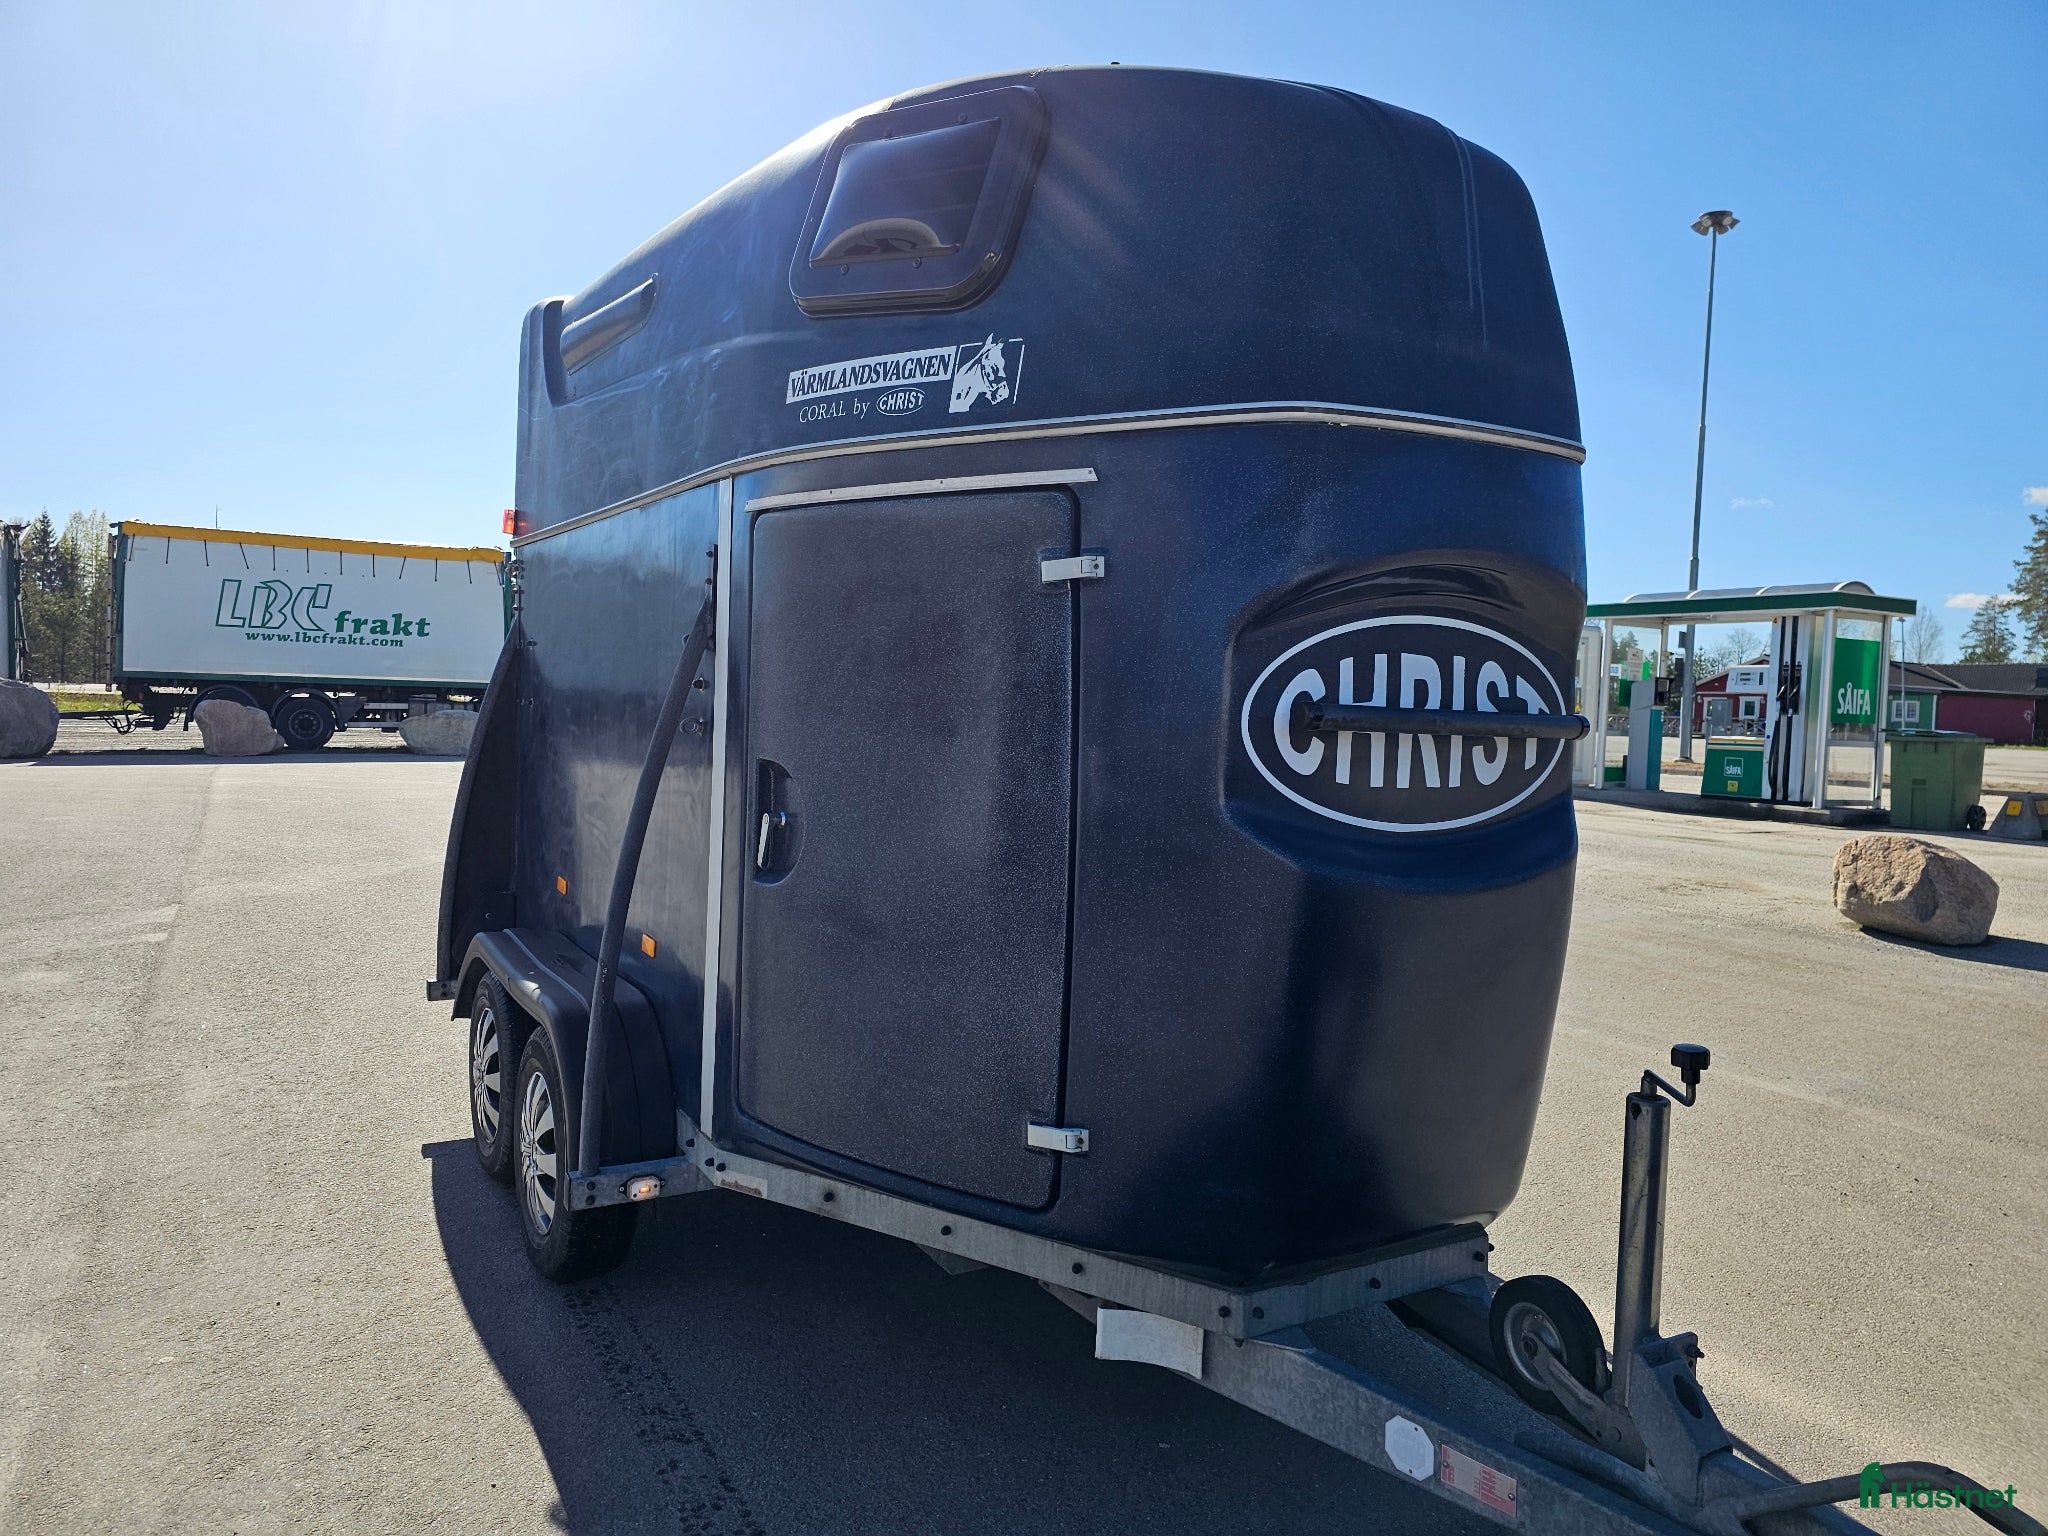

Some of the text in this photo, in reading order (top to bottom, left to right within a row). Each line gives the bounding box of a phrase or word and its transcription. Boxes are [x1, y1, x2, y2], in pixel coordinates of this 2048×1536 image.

[790, 353, 952, 398] VÄRMLANDSVAGNEN
[799, 391, 924, 423] CORAL by CHRIST
[215, 578, 431, 637] LBC frakt
[245, 631, 404, 647] www.lbcfrakt.com
[1837, 682, 1871, 715] SÅIFA
[1273, 652, 1551, 789] CHRIST
